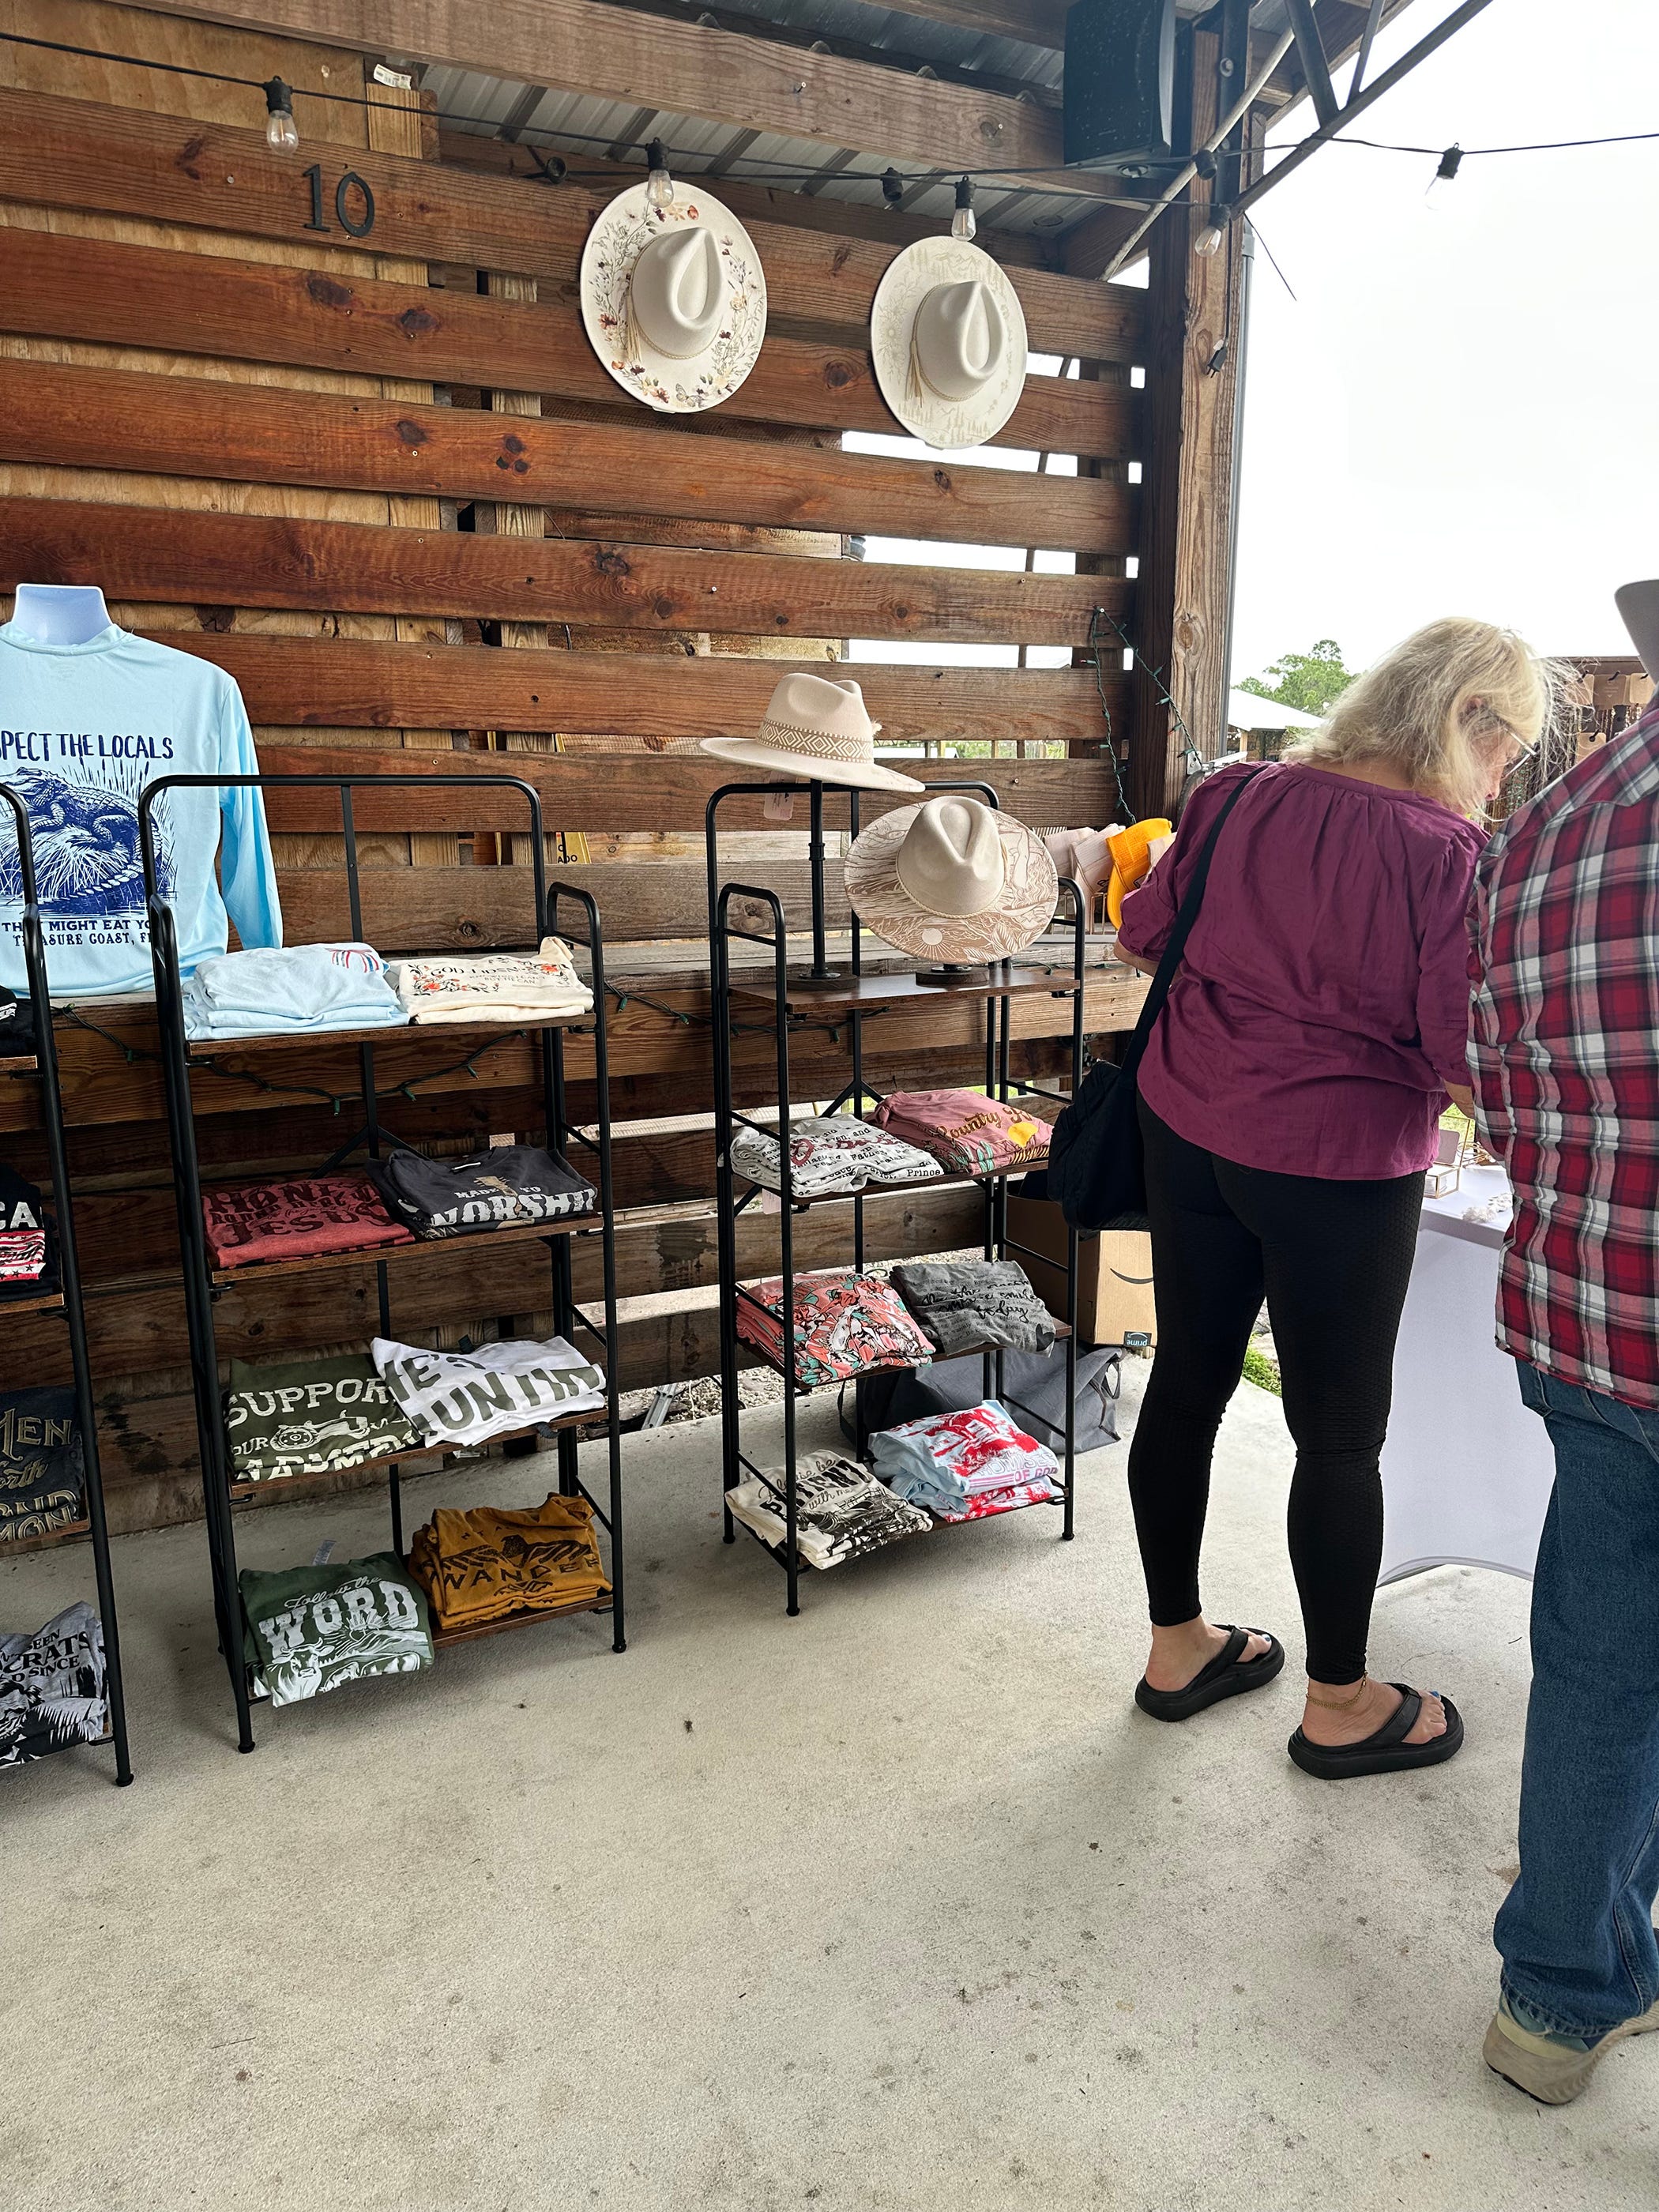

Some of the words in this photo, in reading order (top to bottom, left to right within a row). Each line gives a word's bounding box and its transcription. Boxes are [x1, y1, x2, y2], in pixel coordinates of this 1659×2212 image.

[303, 164, 375, 238] 10
[0, 730, 51, 761] PECT
[56, 733, 94, 757] THE
[98, 735, 174, 759] LOCALS
[49, 920, 97, 931] MIGHT
[103, 920, 130, 930] EAT
[13, 934, 82, 946] TASURE
[89, 932, 135, 945] COAST,
[853, 1127, 871, 1138] and
[907, 1168, 941, 1177] Prince
[454, 1188, 499, 1198] MADE
[221, 1202, 395, 1247] JESUS
[228, 1378, 390, 1428] SUPPOR
[231, 1436, 269, 1456] OUR
[815, 1459, 836, 1472] be
[1014, 1469, 1030, 1482] OF
[808, 1490, 835, 1510] with
[284, 1585, 352, 1609] Follow
[258, 1580, 419, 1659] WORD
[28, 1655, 80, 1678] SINCE
